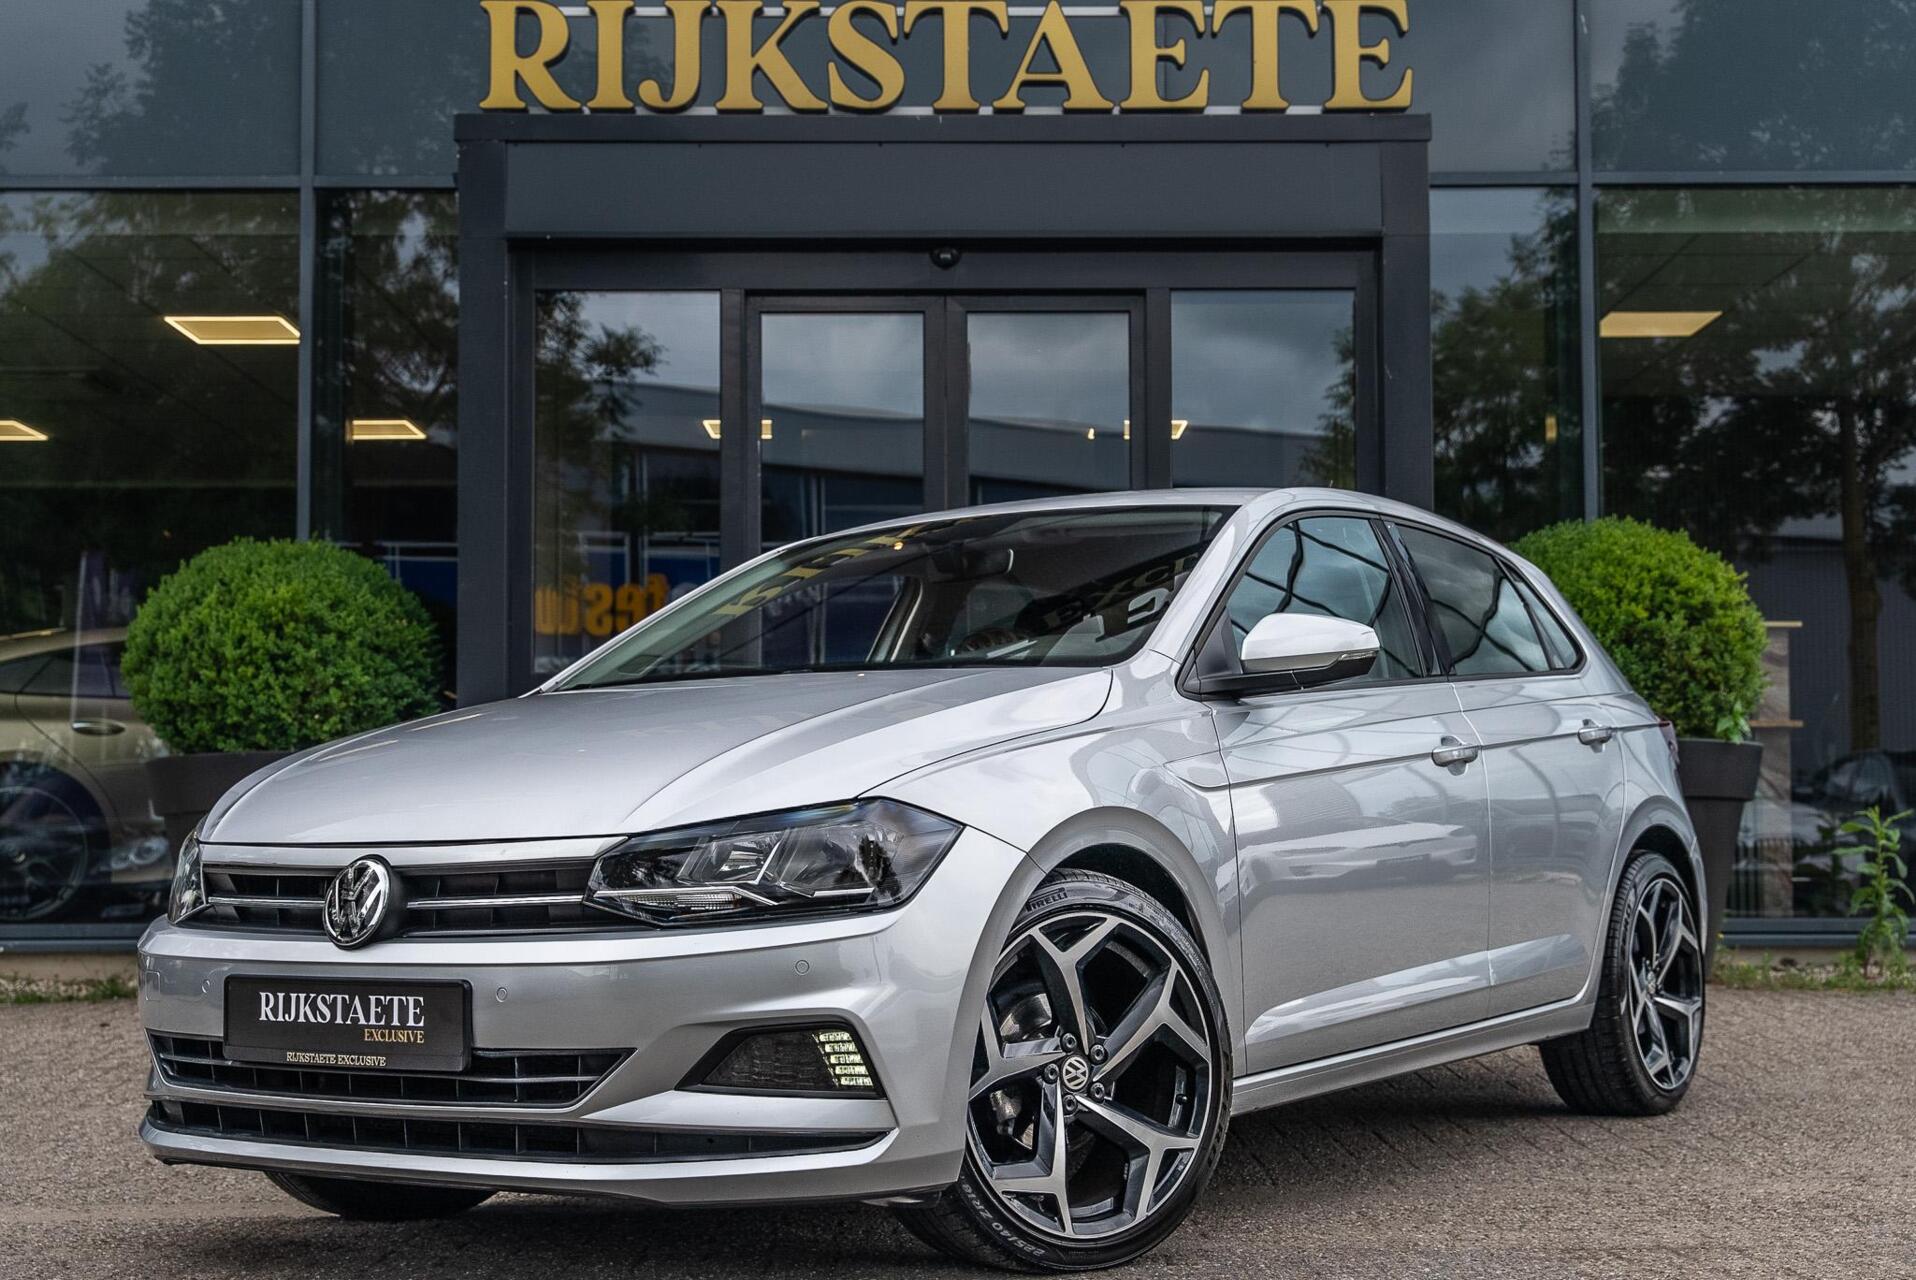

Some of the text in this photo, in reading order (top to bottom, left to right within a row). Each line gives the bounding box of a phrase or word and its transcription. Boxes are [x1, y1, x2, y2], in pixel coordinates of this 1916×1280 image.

[479, 0, 1413, 111] RIJKSTAETE
[258, 991, 425, 1027] RIJKSTAETE
[363, 1028, 425, 1044] EXCLUSIVE
[286, 1051, 387, 1067] RIJKSTAETE EXCLUSIVE
